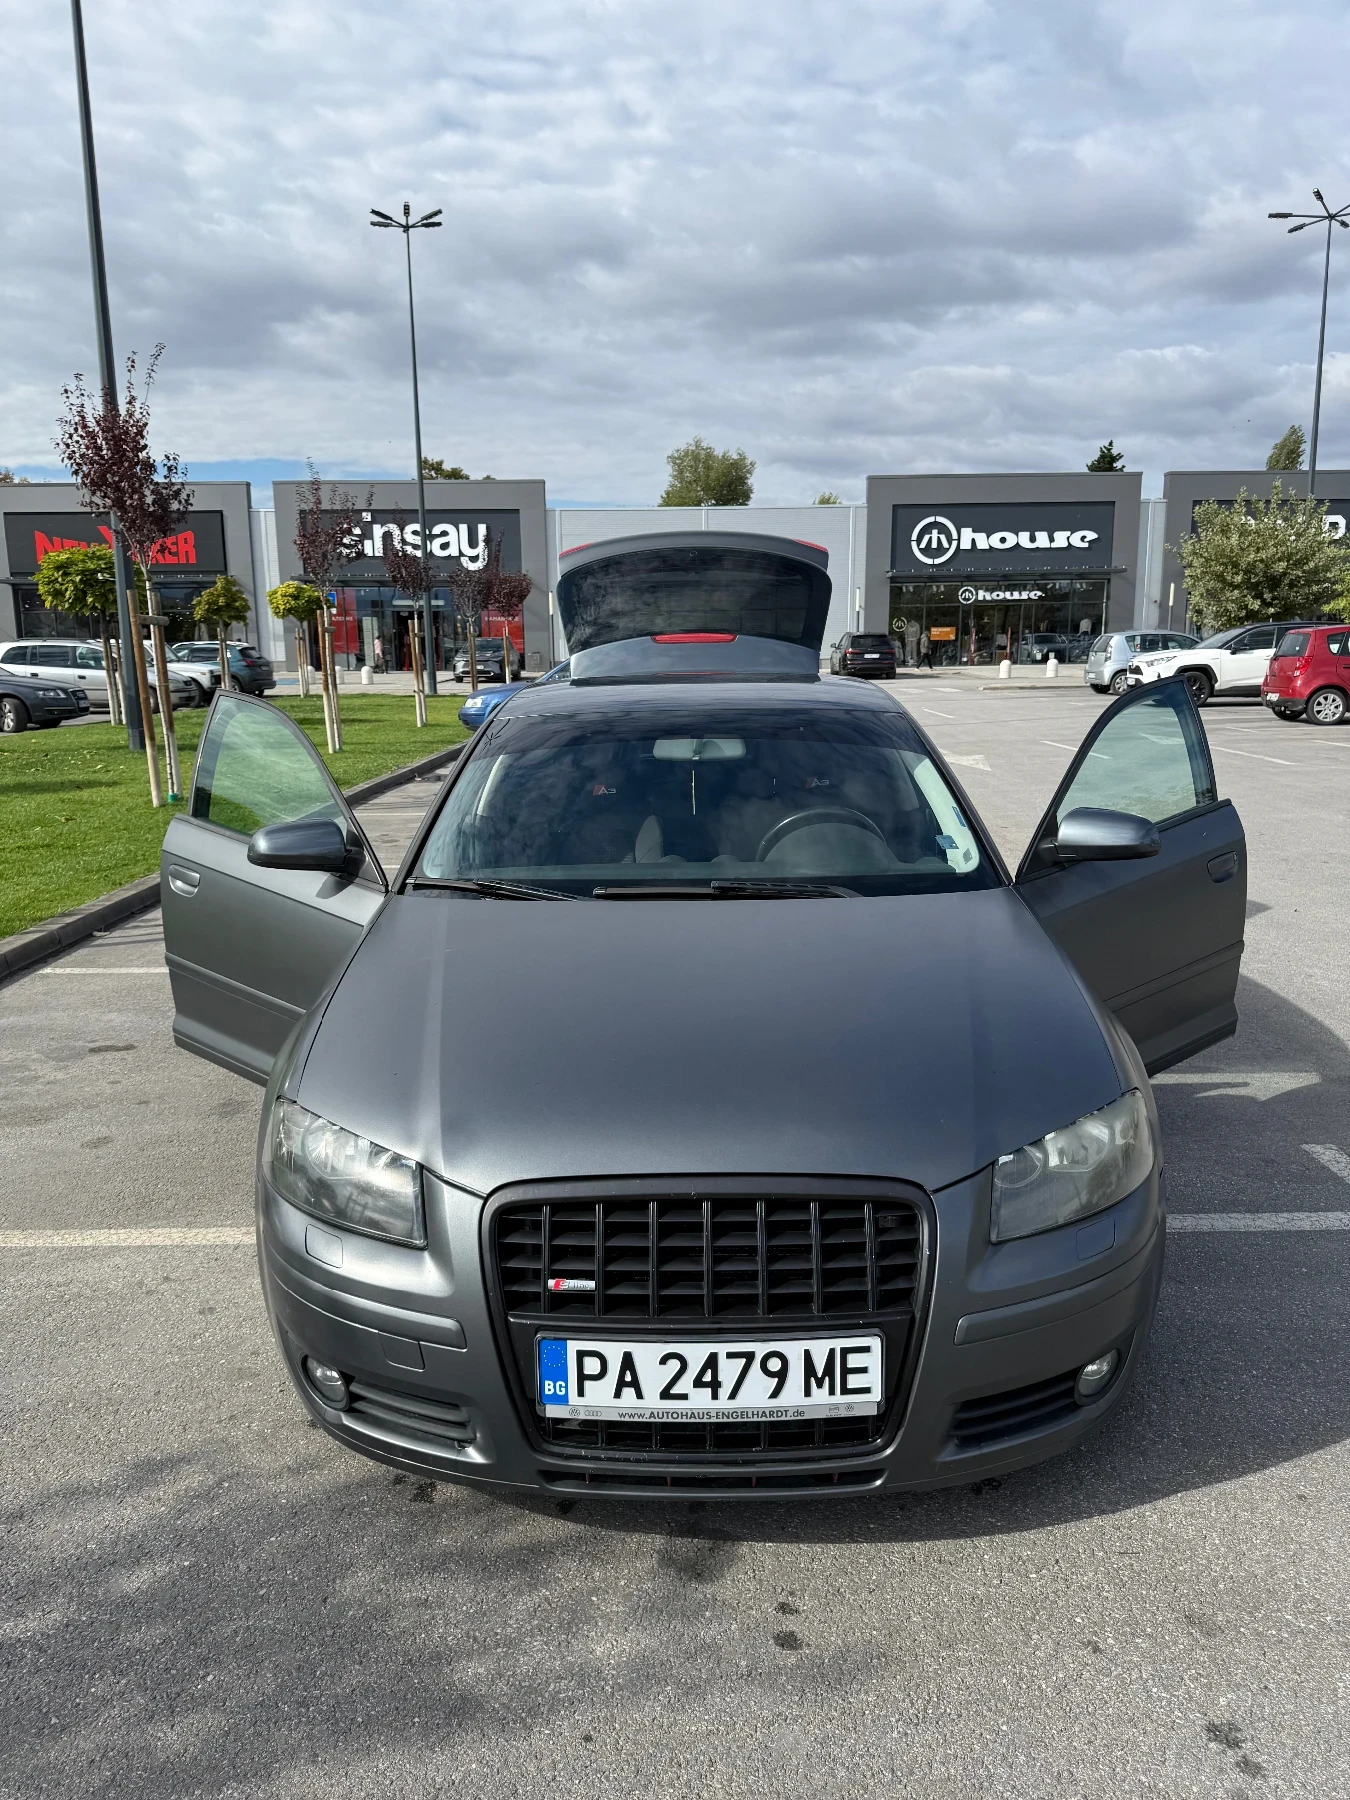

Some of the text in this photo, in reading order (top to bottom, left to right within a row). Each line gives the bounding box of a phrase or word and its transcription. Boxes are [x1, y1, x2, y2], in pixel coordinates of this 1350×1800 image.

[337, 511, 488, 571] sinsay
[959, 527, 1099, 550] house
[977, 589, 1043, 601] house
[811, 778, 830, 787] A3
[598, 786, 617, 795] A3
[575, 1345, 872, 1401] PA 2479 ME
[544, 1380, 566, 1396] BG
[618, 1409, 806, 1420] www.AUTOHAUS-ENGELHARDT.de
